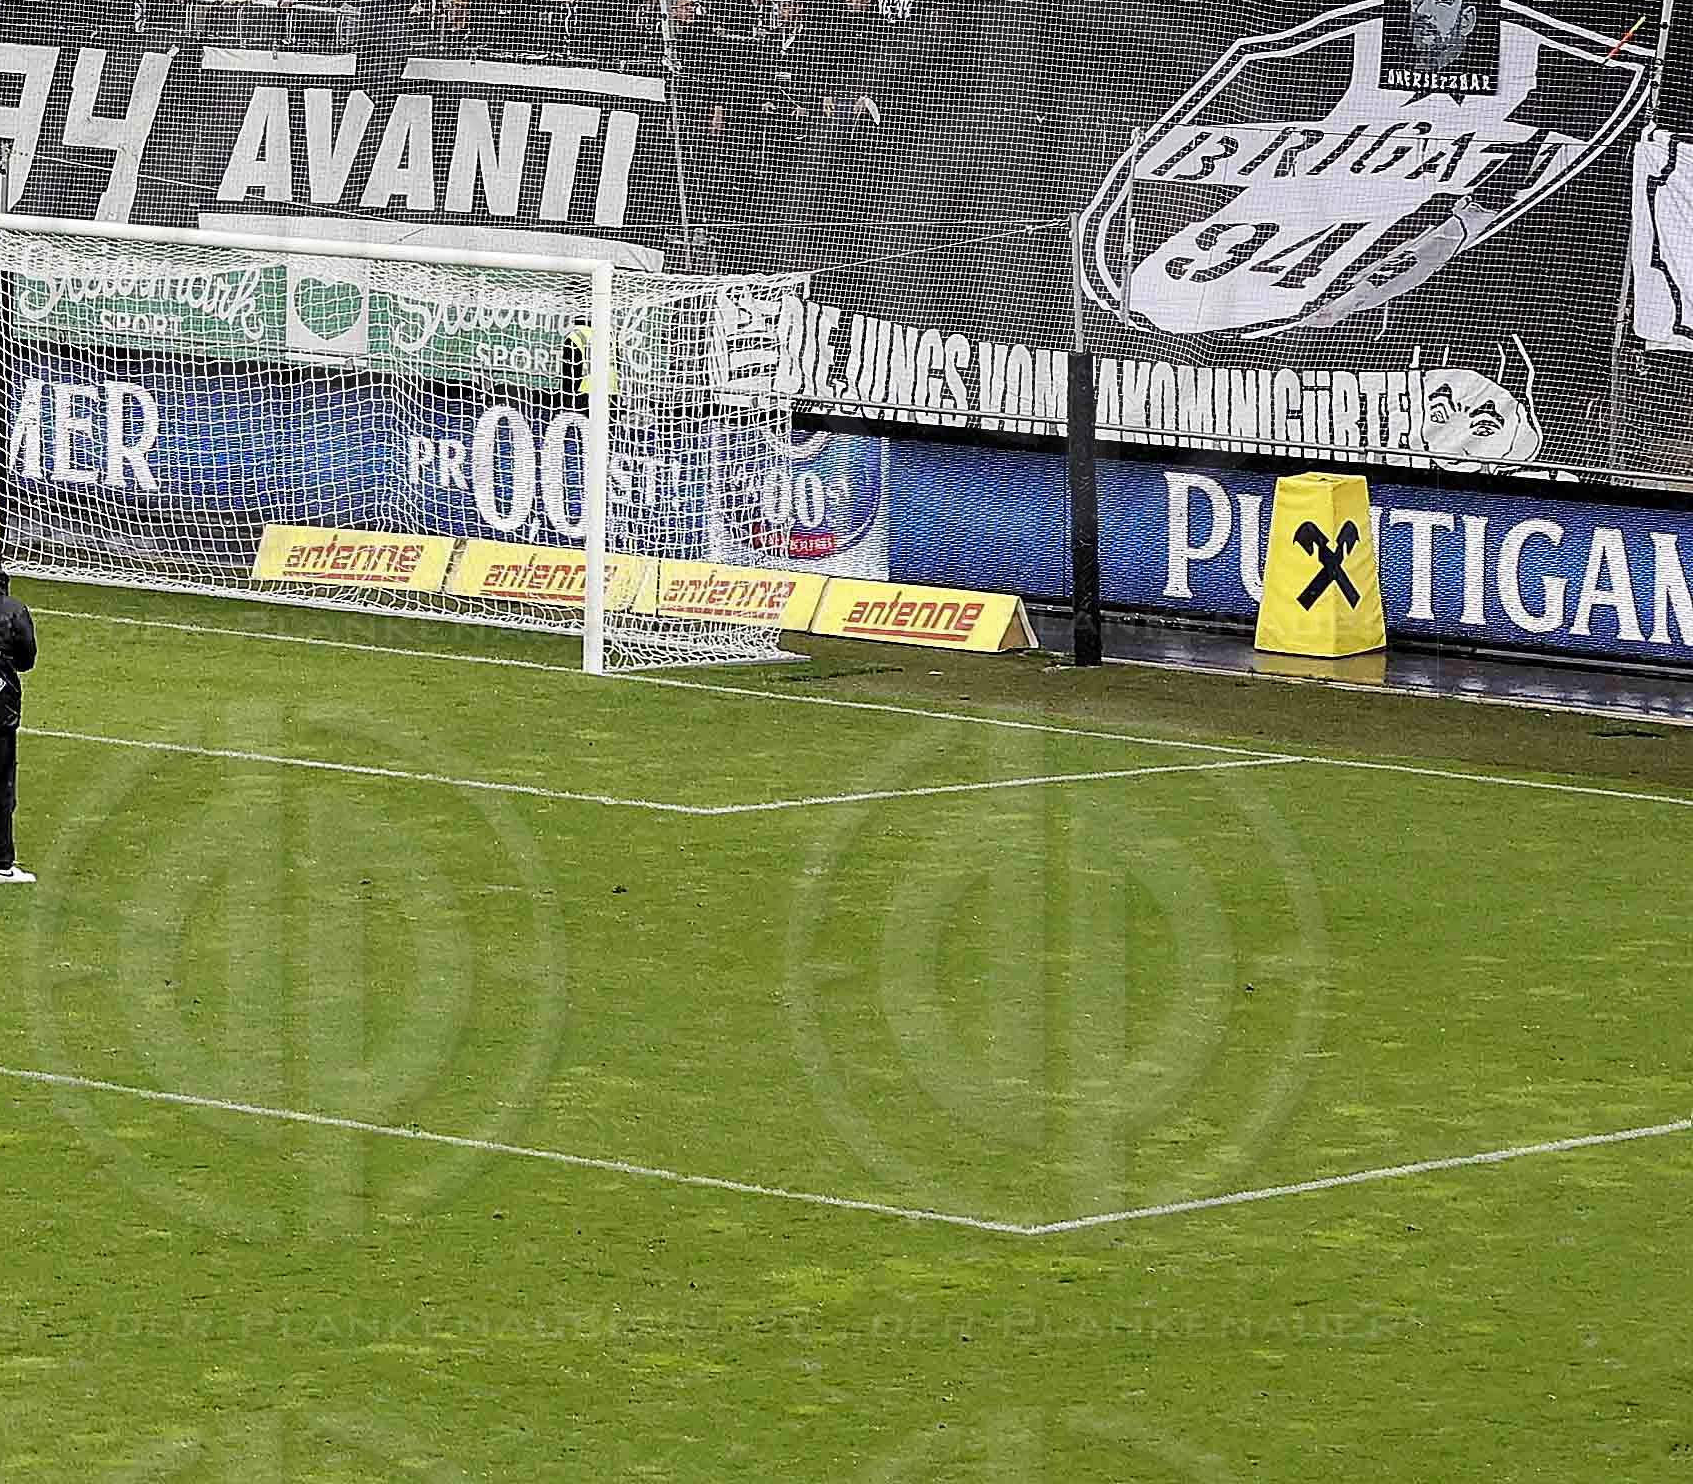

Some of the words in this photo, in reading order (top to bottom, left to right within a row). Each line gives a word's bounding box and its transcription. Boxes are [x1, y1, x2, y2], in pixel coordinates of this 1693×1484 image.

[216, 85, 639, 229] AVANTI
[99, 312, 184, 337] SPORT
[776, 292, 841, 402] DIE
[841, 315, 971, 424] JUNGS
[977, 341, 1068, 434] VOM
[283, 531, 425, 575] antenne
[661, 572, 796, 612] antenne
[842, 593, 985, 635] antenne
